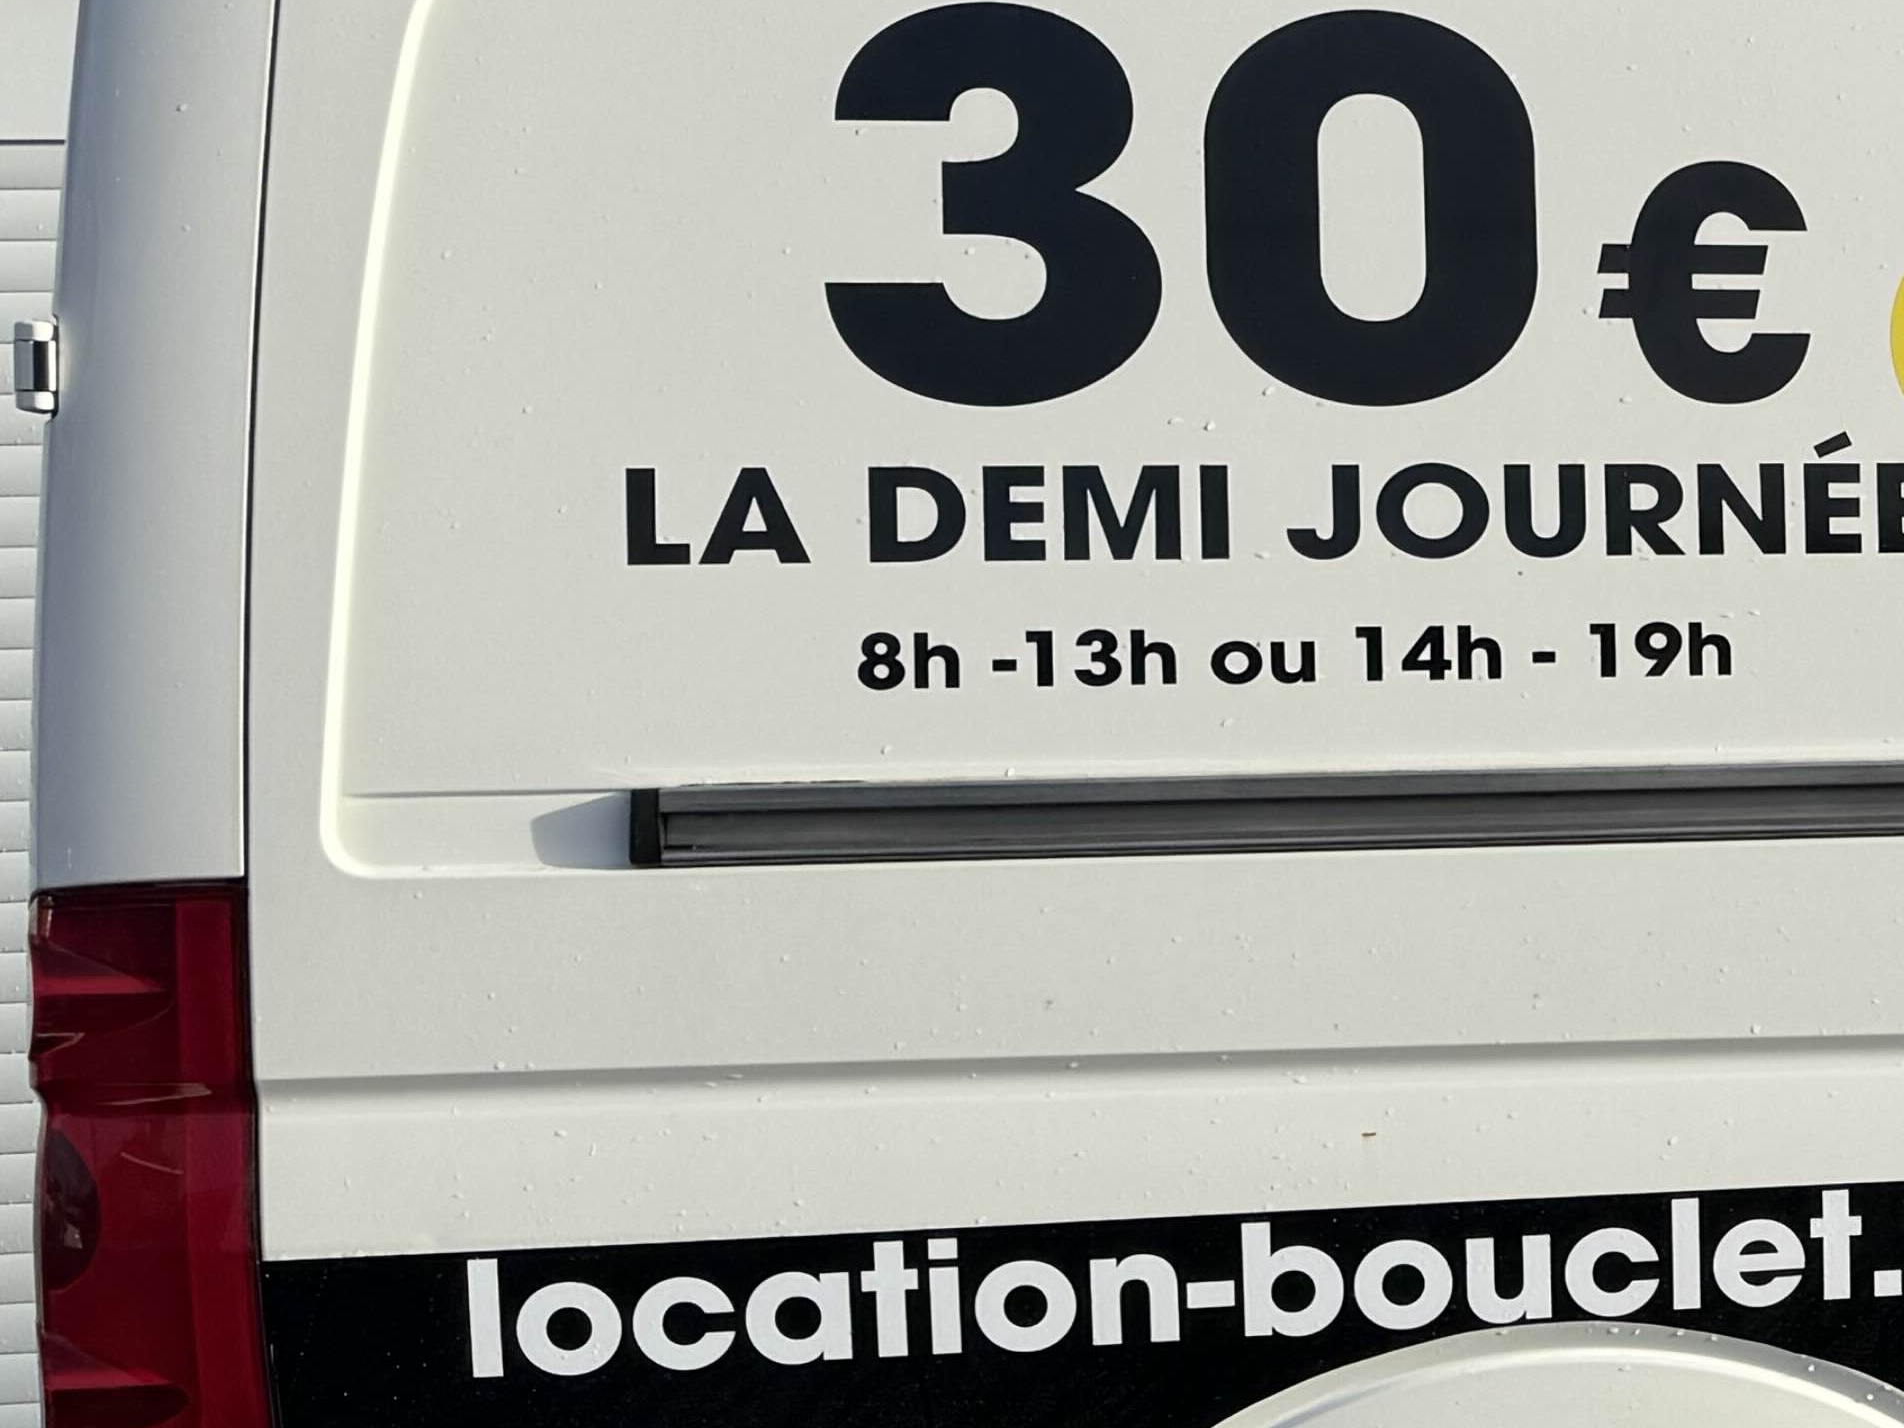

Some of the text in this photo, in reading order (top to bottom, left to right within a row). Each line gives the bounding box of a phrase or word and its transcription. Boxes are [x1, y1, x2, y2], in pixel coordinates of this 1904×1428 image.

[625, 467, 811, 566] LA
[867, 464, 1230, 563] DEMI
[857, 631, 960, 691] 8h
[1210, 639, 1316, 685] ou
[1355, 624, 1502, 682] 14h
[1589, 621, 1732, 678] 19h
